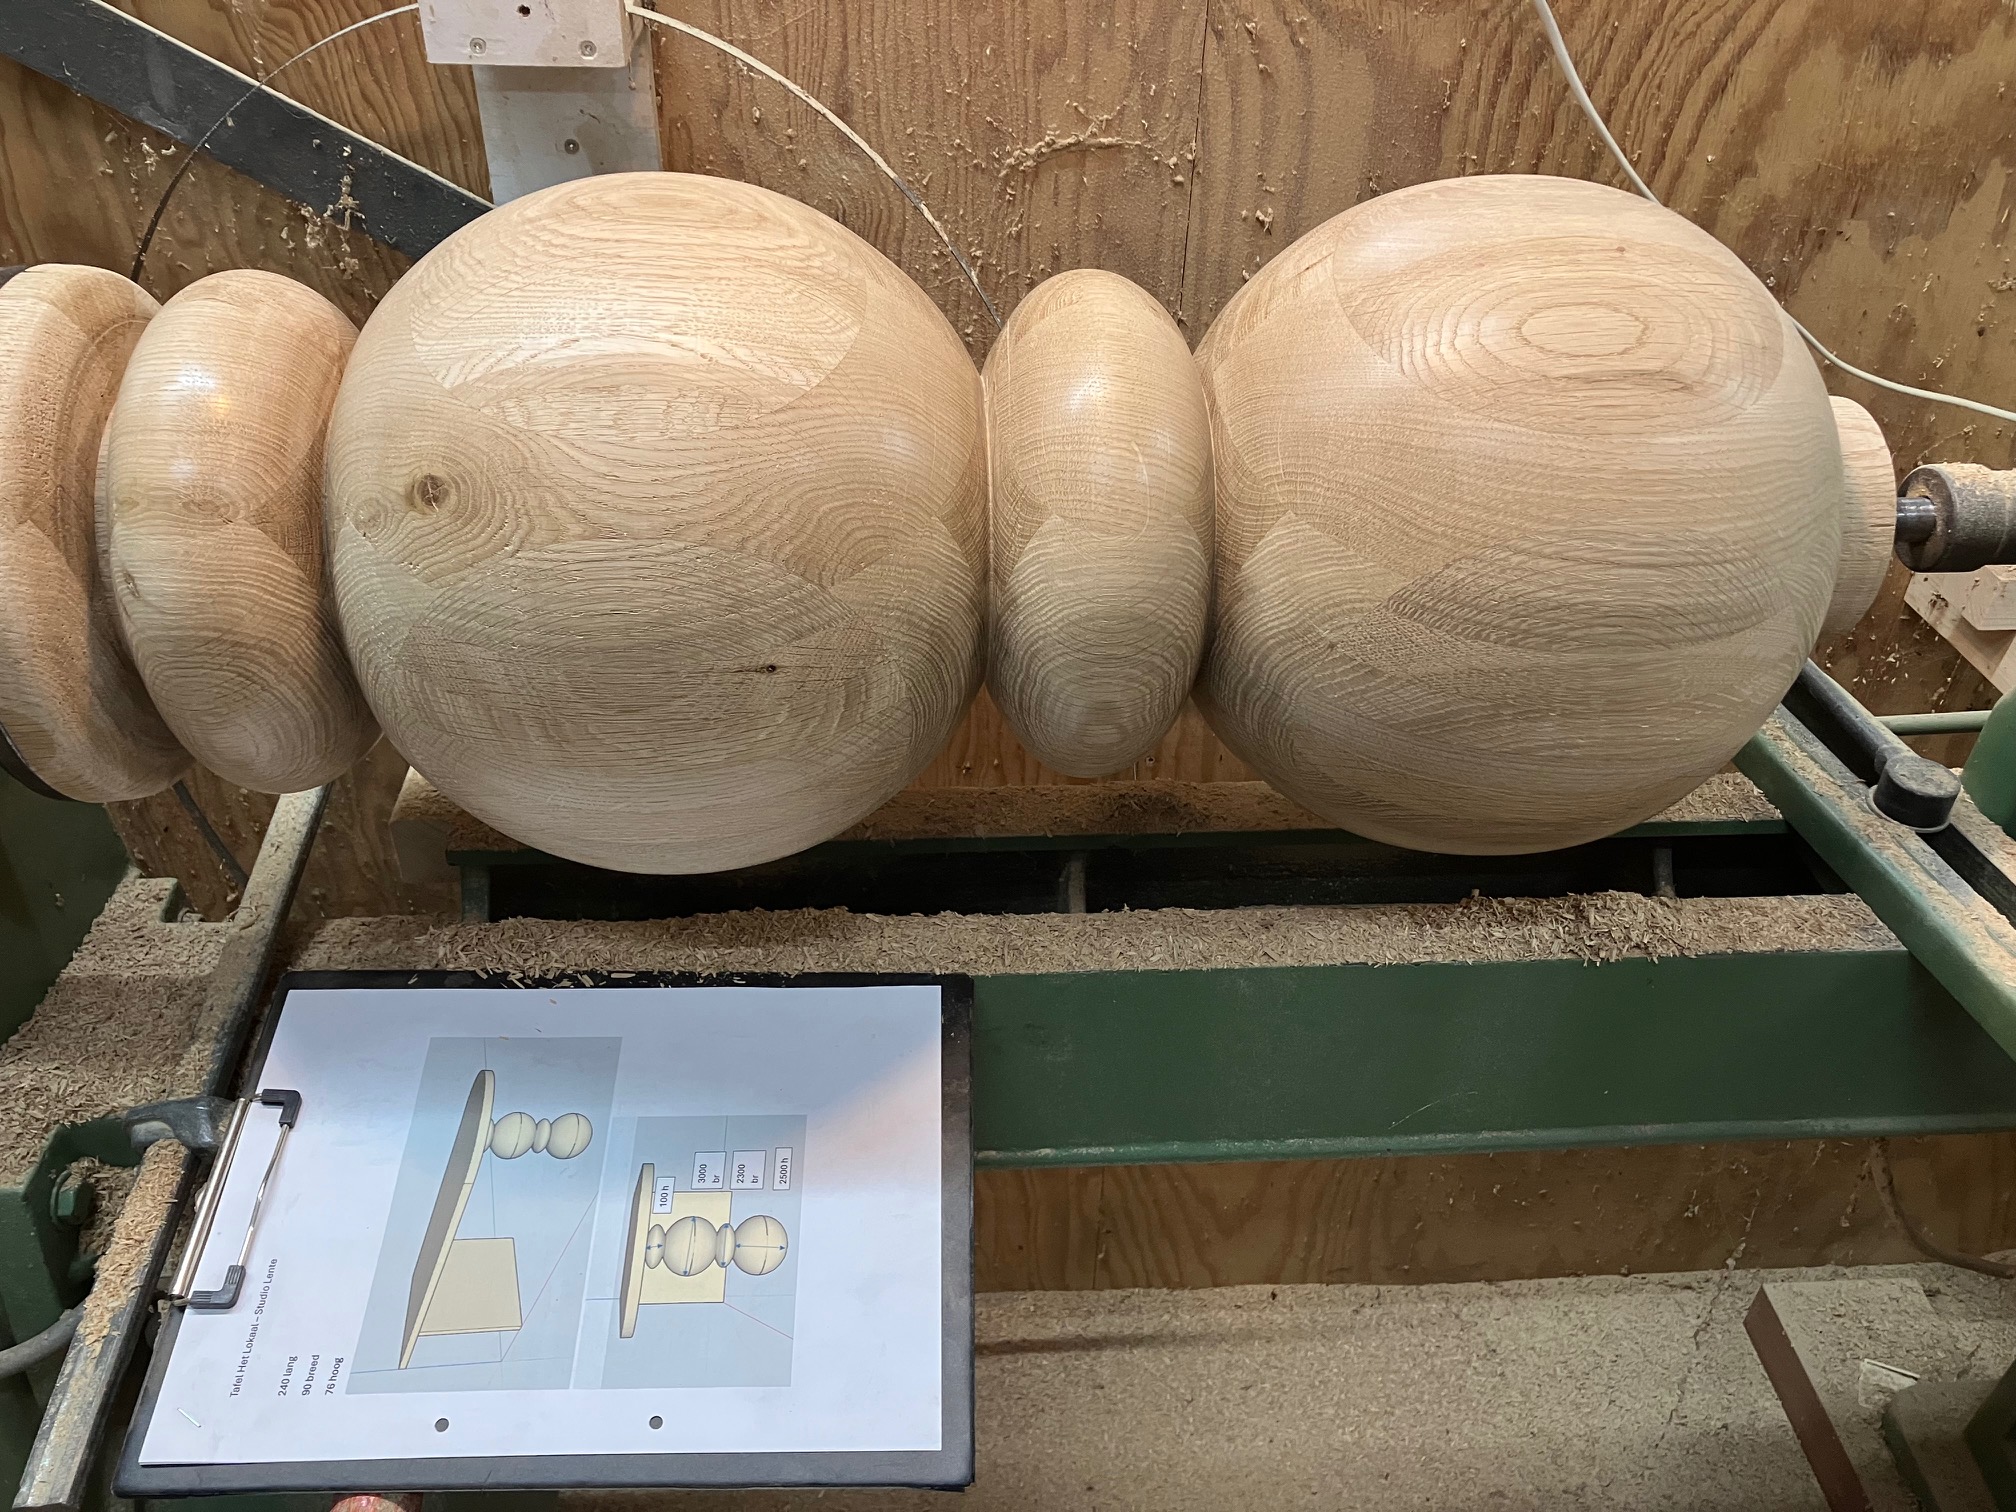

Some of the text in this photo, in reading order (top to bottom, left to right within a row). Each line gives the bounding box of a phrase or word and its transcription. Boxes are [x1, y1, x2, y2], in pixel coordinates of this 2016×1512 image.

[698, 1164, 708, 1184] 3000
[712, 1174, 720, 1184] br
[736, 1164, 746, 1184] 2300
[751, 1174, 759, 1184] br
[779, 1164, 788, 1184] 2500
[660, 1192, 668, 1207] 100
[263, 1258, 278, 1284] Lente
[254, 1285, 270, 1316] Studio
[242, 1324, 259, 1354] Lokaal
[236, 1355, 250, 1373] Het
[302, 1354, 320, 1396] 90 breed
[230, 1374, 244, 1398] Tafel
[278, 1356, 298, 1396] 240 lang
[325, 1357, 344, 1396] 76 hoog
